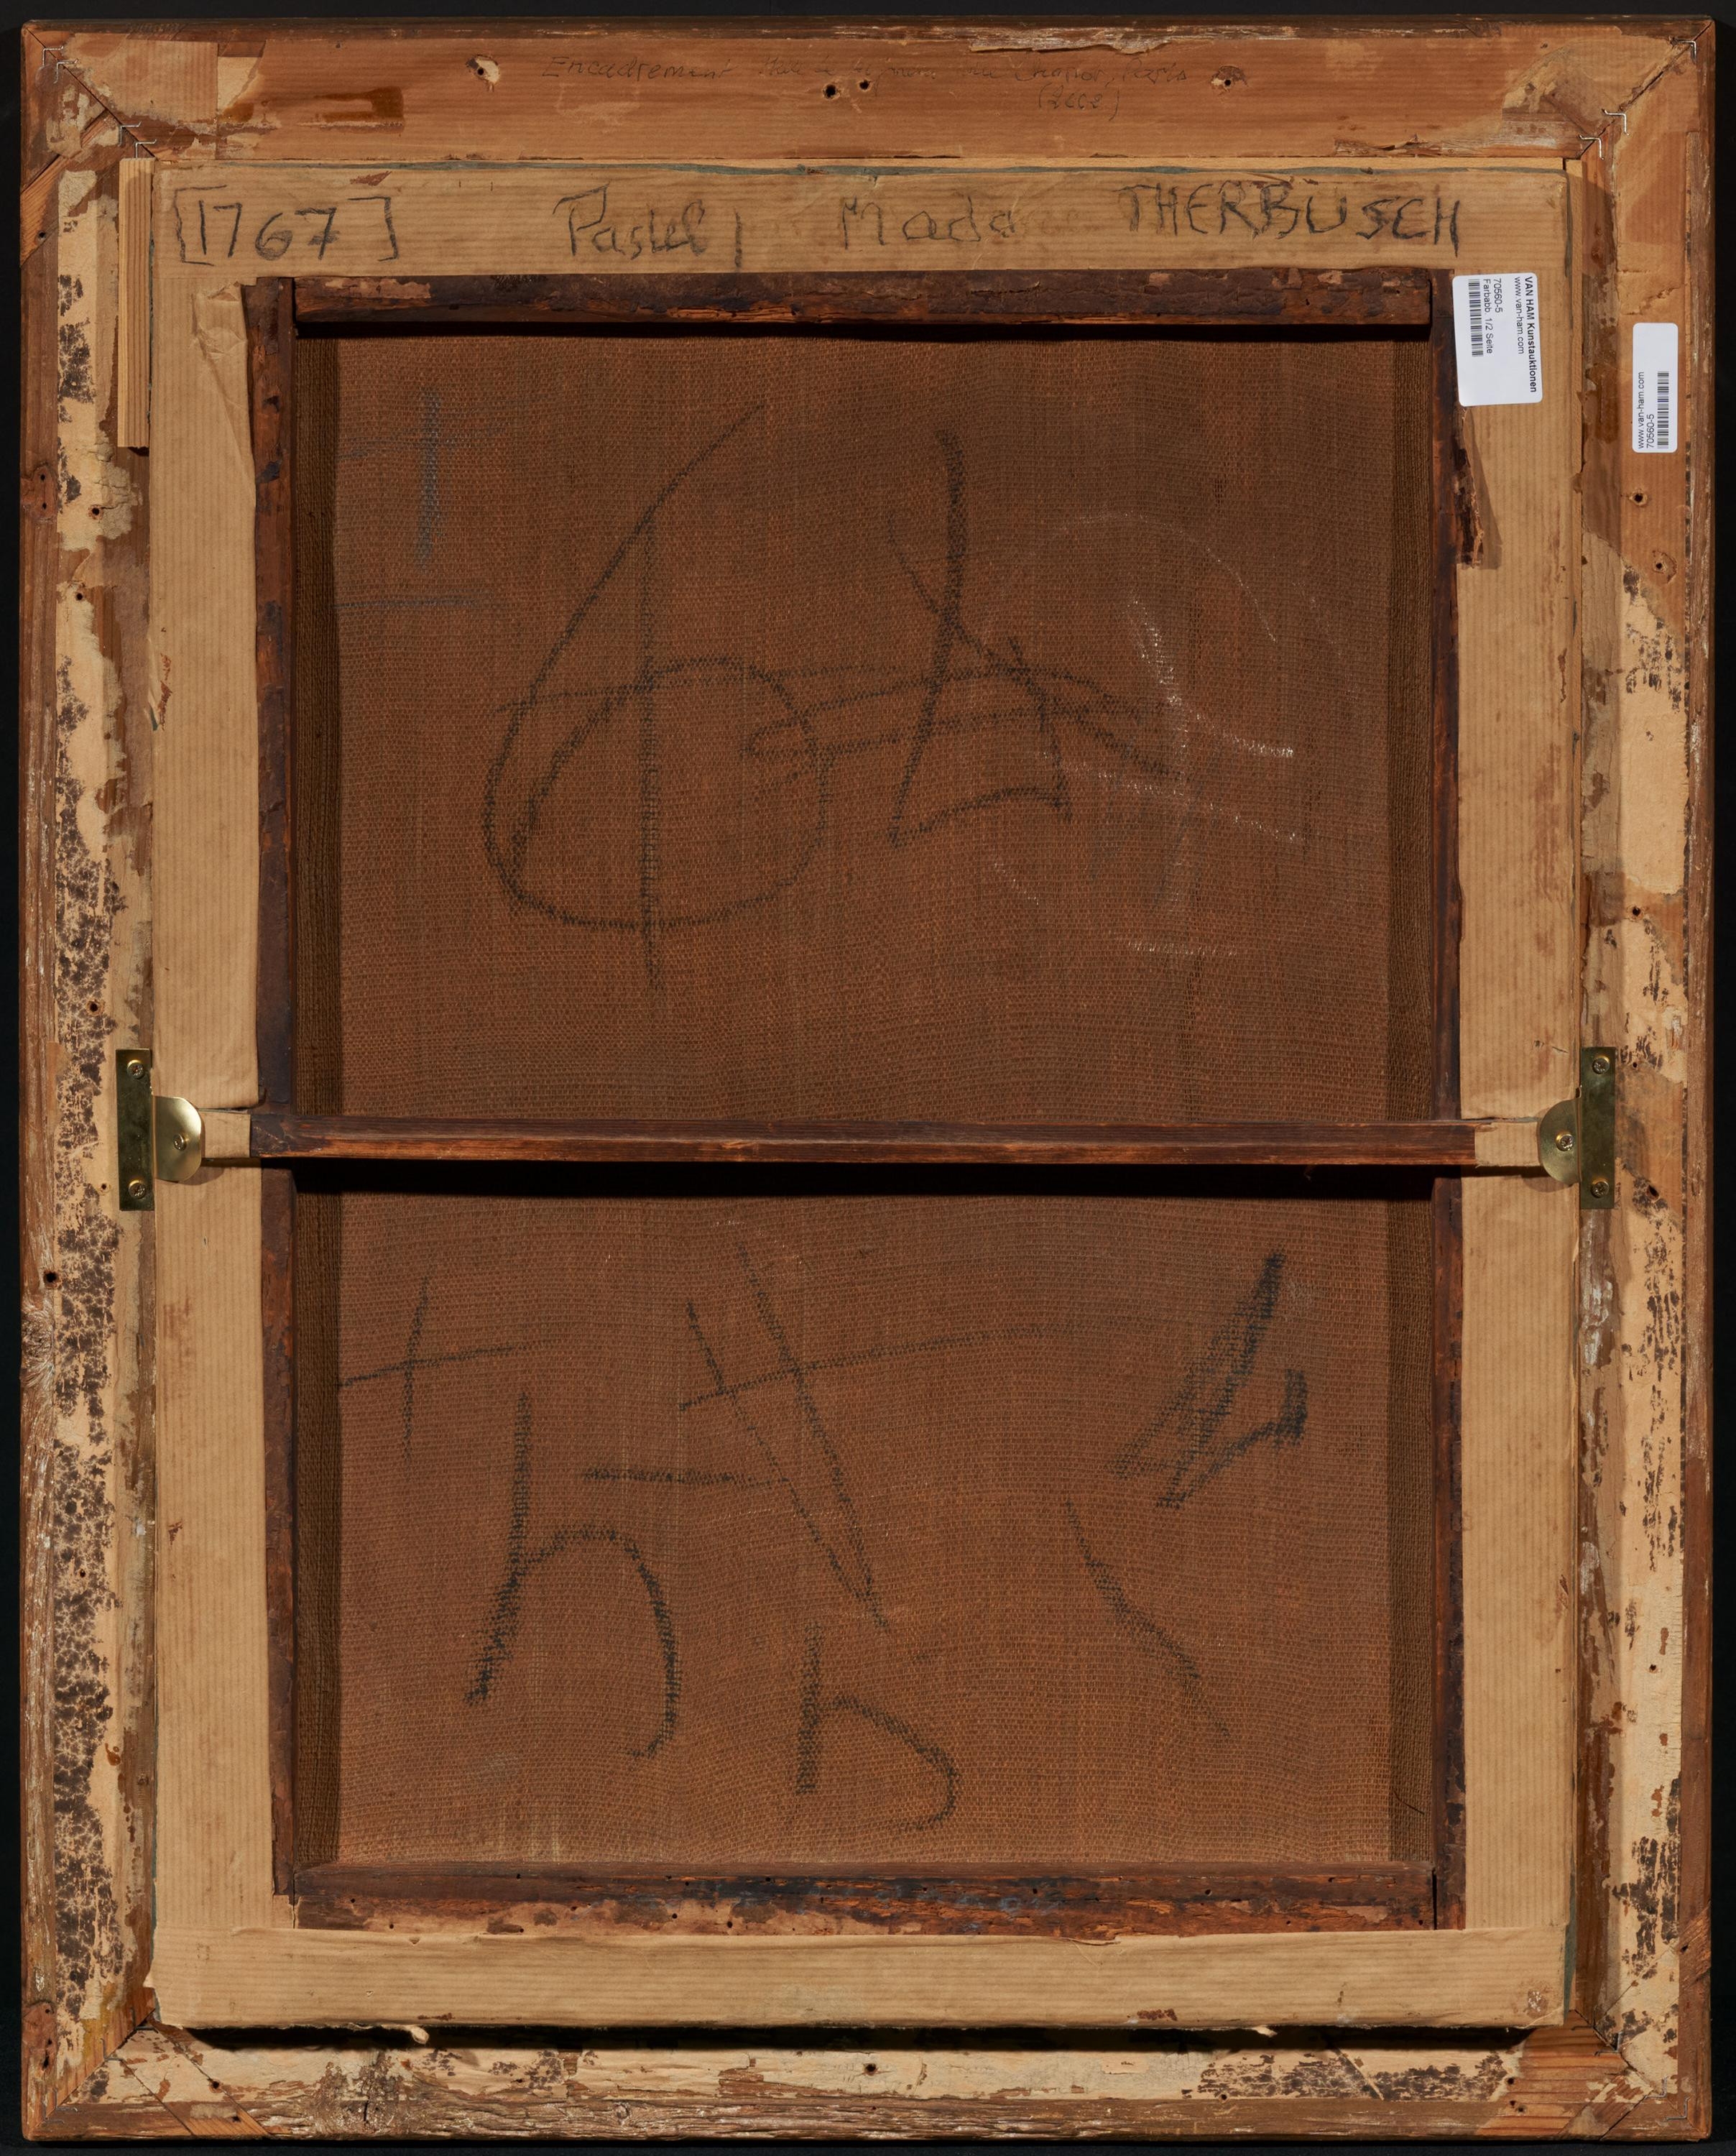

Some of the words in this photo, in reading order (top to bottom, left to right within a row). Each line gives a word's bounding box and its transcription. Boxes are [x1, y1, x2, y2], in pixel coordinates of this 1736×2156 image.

[1112, 180, 1460, 259] THERBUSCH
[1482, 278, 1492, 315] Farbabb.
[1493, 277, 1503, 313] 70560-5
[1524, 276, 1534, 296] VAN
[1485, 318, 1494, 331] 1/2
[1514, 276, 1525, 354] www.van-ham.com
[1525, 299, 1536, 320] HAM
[1527, 323, 1538, 393] Kunstauktionen
[1636, 372, 1645, 449] www.van-ham.com
[1646, 413, 1655, 449] 70560-5
